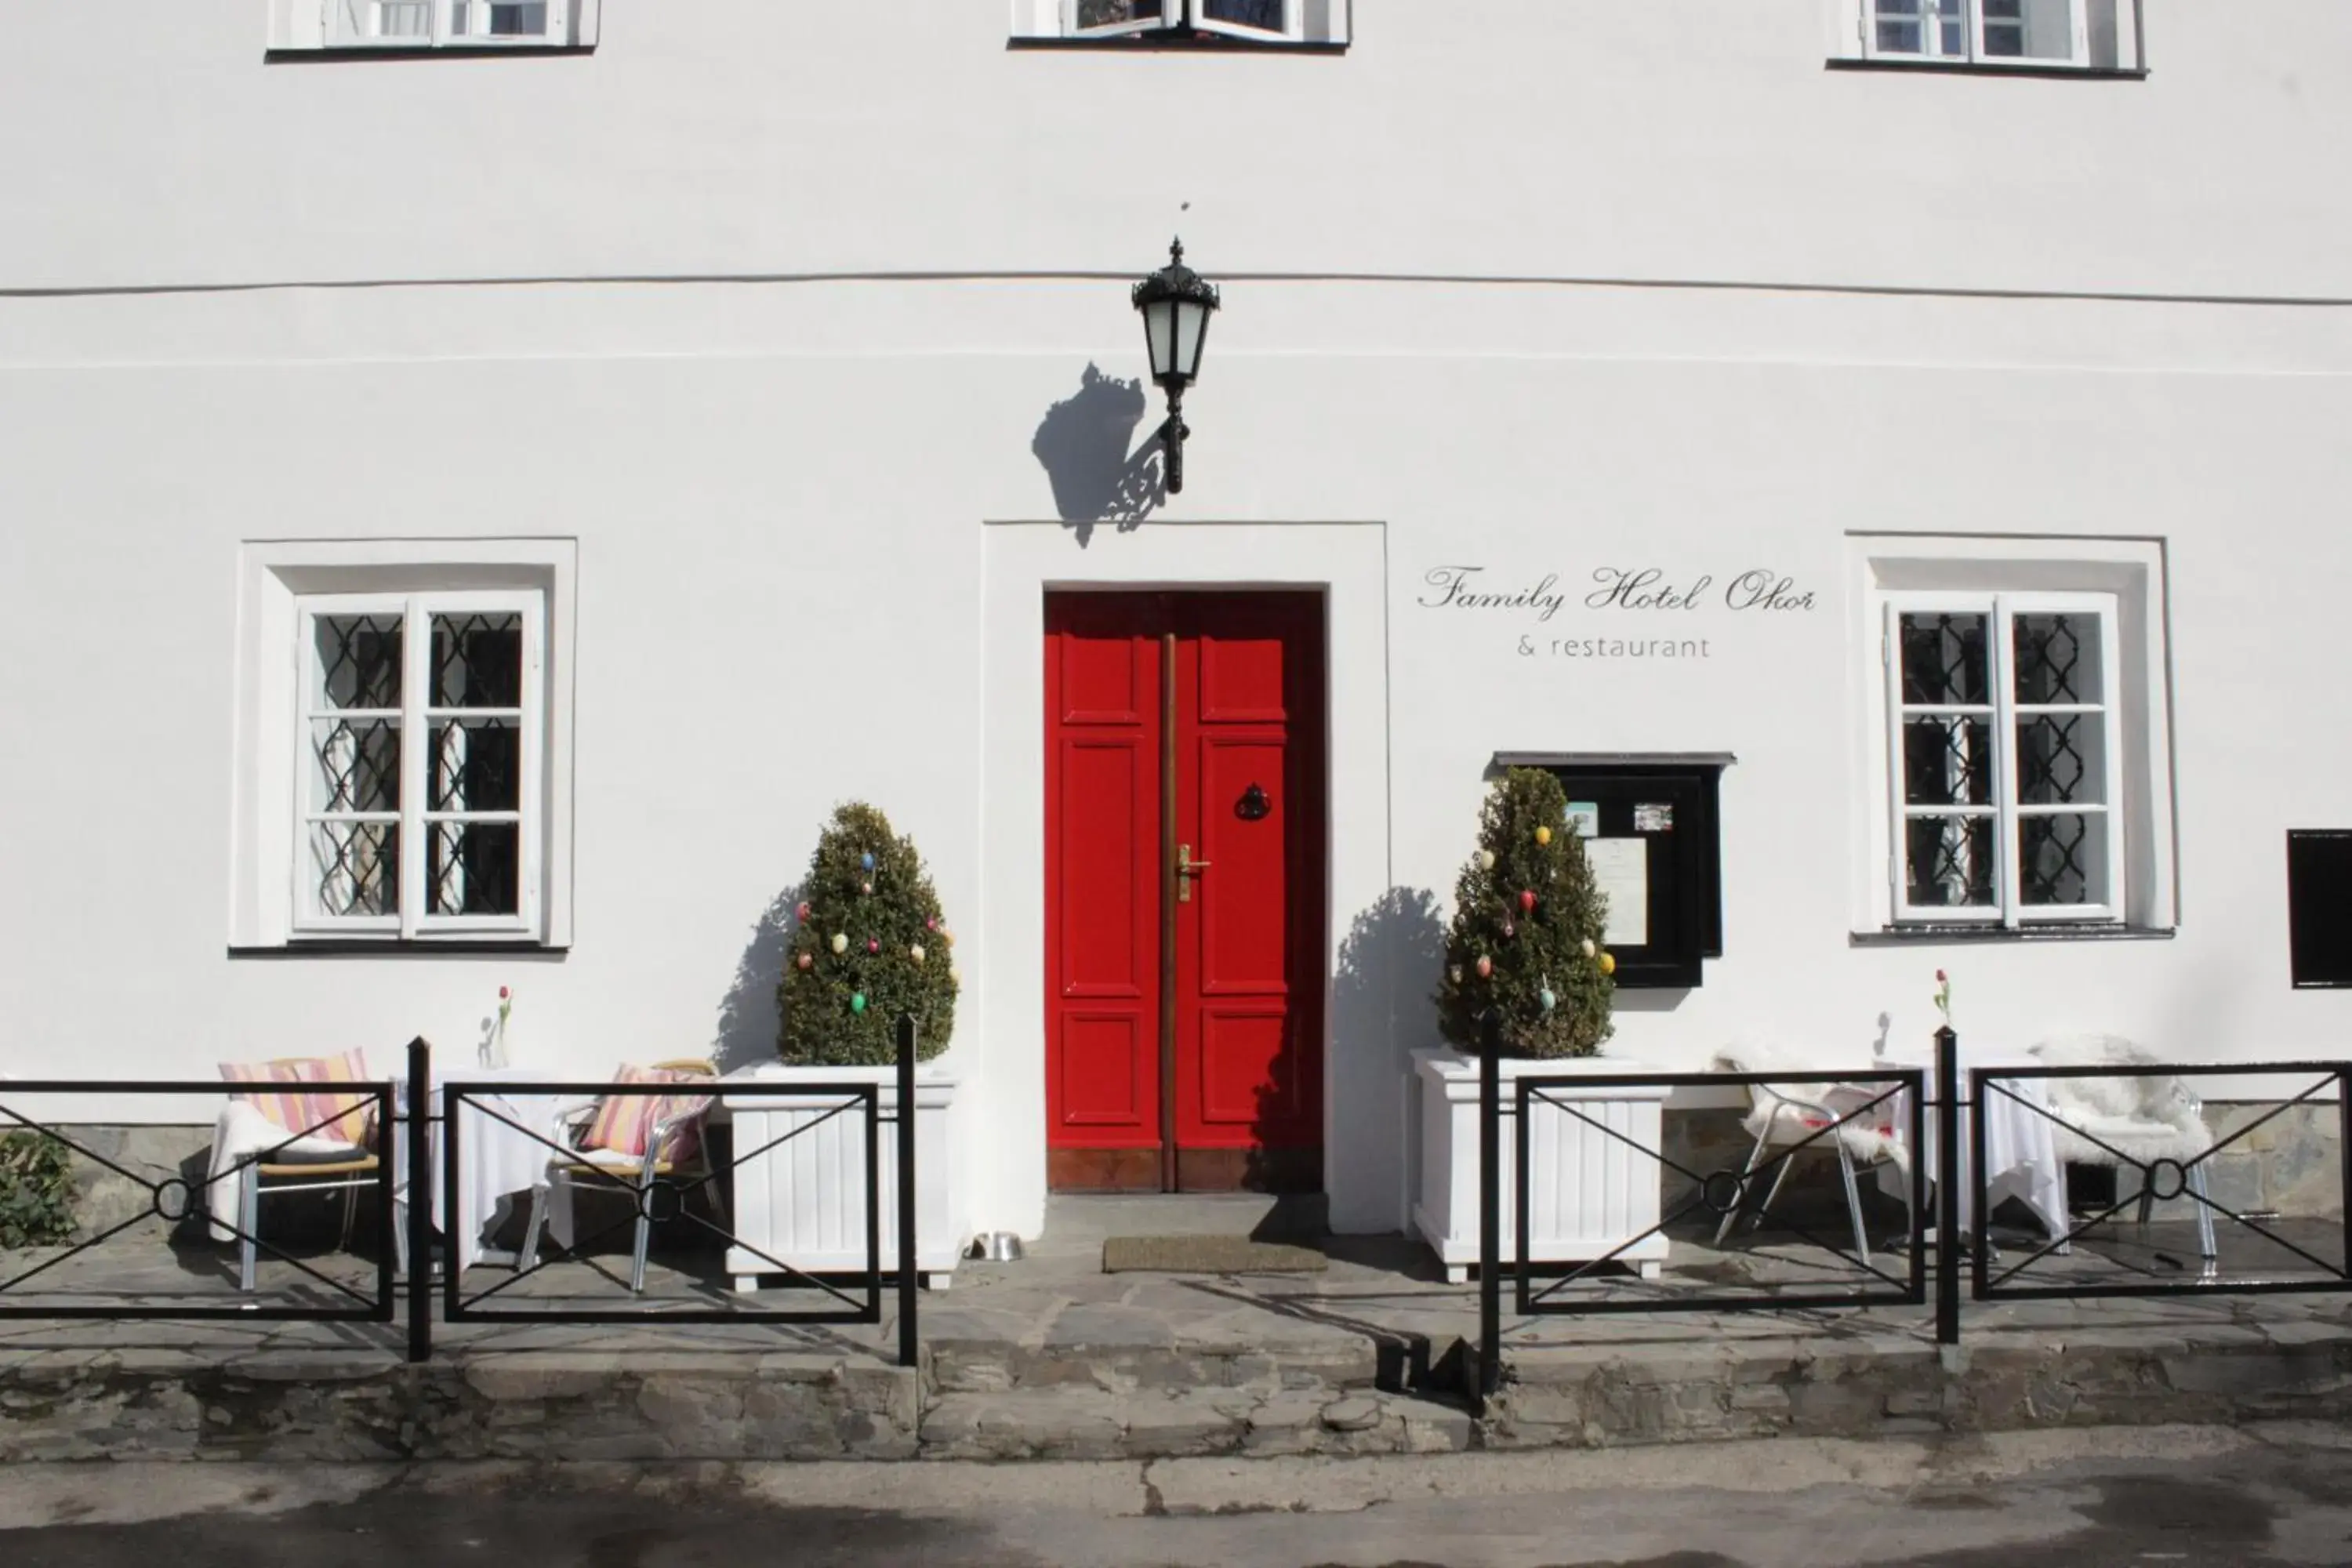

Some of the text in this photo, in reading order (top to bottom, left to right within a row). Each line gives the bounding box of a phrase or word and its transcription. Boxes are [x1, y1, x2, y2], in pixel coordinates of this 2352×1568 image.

[1417, 565, 1566, 622] Family
[1584, 566, 1713, 611] Hotel
[1517, 634, 1710, 658] & restaurant
